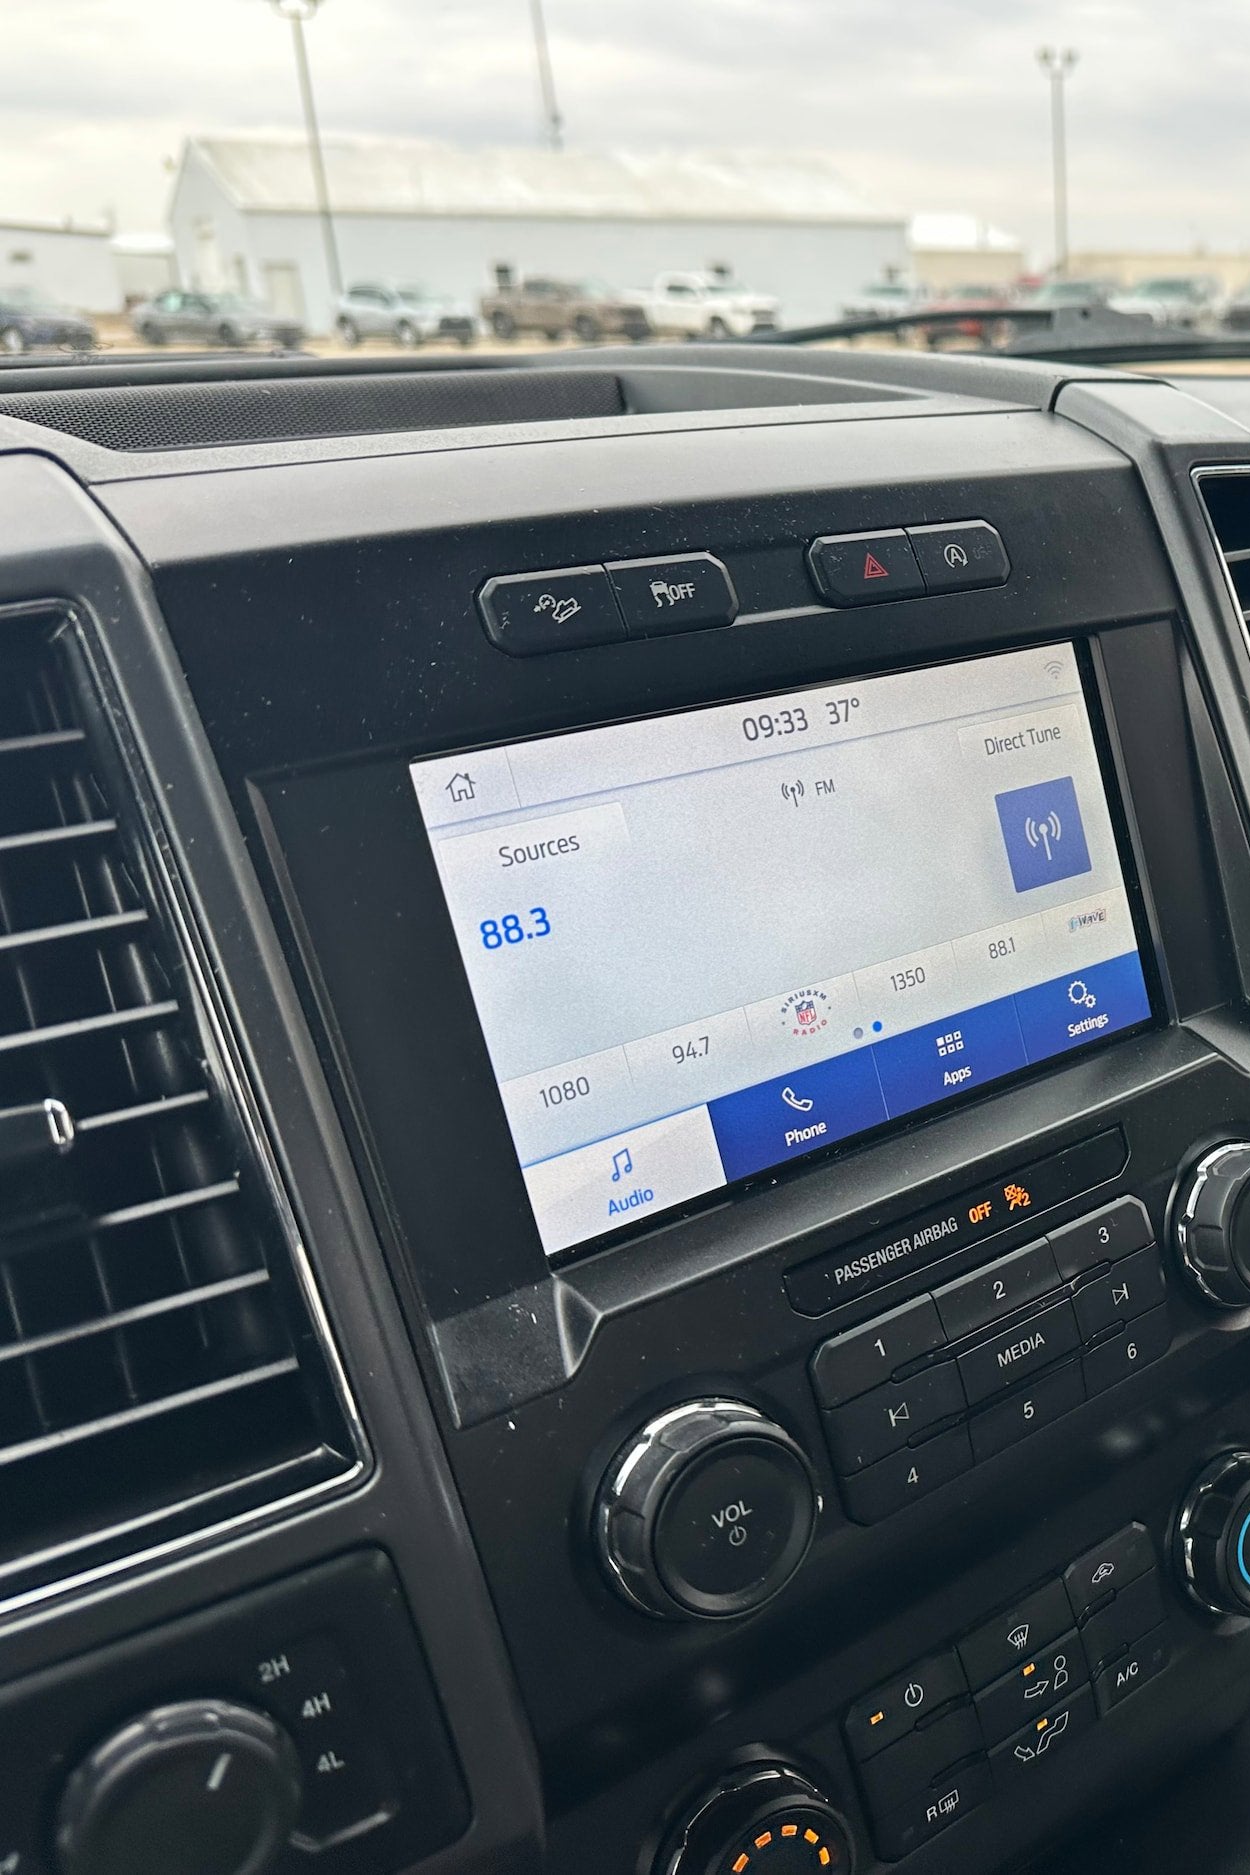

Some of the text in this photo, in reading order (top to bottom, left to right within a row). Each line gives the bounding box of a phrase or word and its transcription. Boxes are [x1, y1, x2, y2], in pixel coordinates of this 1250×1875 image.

[669, 583, 695, 600] OFF
[742, 709, 809, 742] 09:33
[984, 725, 1061, 756] Direct Tune
[815, 780, 835, 796] FM
[498, 833, 581, 868] Sources
[479, 907, 552, 952] 88.3
[988, 936, 1018, 960] 88.1
[890, 967, 926, 993] 1350
[781, 990, 827, 1013] SIRIUSXM
[793, 1019, 827, 1036] RADIO
[797, 1008, 816, 1024] NFL
[1067, 1011, 1110, 1039] Settings
[671, 1036, 711, 1064] 94.7
[942, 1066, 973, 1090] Apps
[540, 1077, 591, 1107] 1080
[785, 1119, 828, 1147] Phone
[606, 1187, 654, 1217] Audio
[834, 1201, 992, 1285] PASSENGER AIRBAG OFF
[1099, 1227, 1110, 1244] 3
[993, 1280, 1006, 1299] 2
[874, 1338, 888, 1357] 1
[996, 1332, 1046, 1367] MEDIA
[1126, 1342, 1137, 1360] 6
[1023, 1401, 1034, 1419] 5
[906, 1467, 919, 1485] 4
[711, 1500, 752, 1529] VOL
[257, 1655, 290, 1684] 2H
[1115, 1661, 1139, 1687] A/C
[301, 1692, 332, 1719] 4H
[316, 1751, 345, 1775] 4L
[926, 1806, 937, 1822] R
